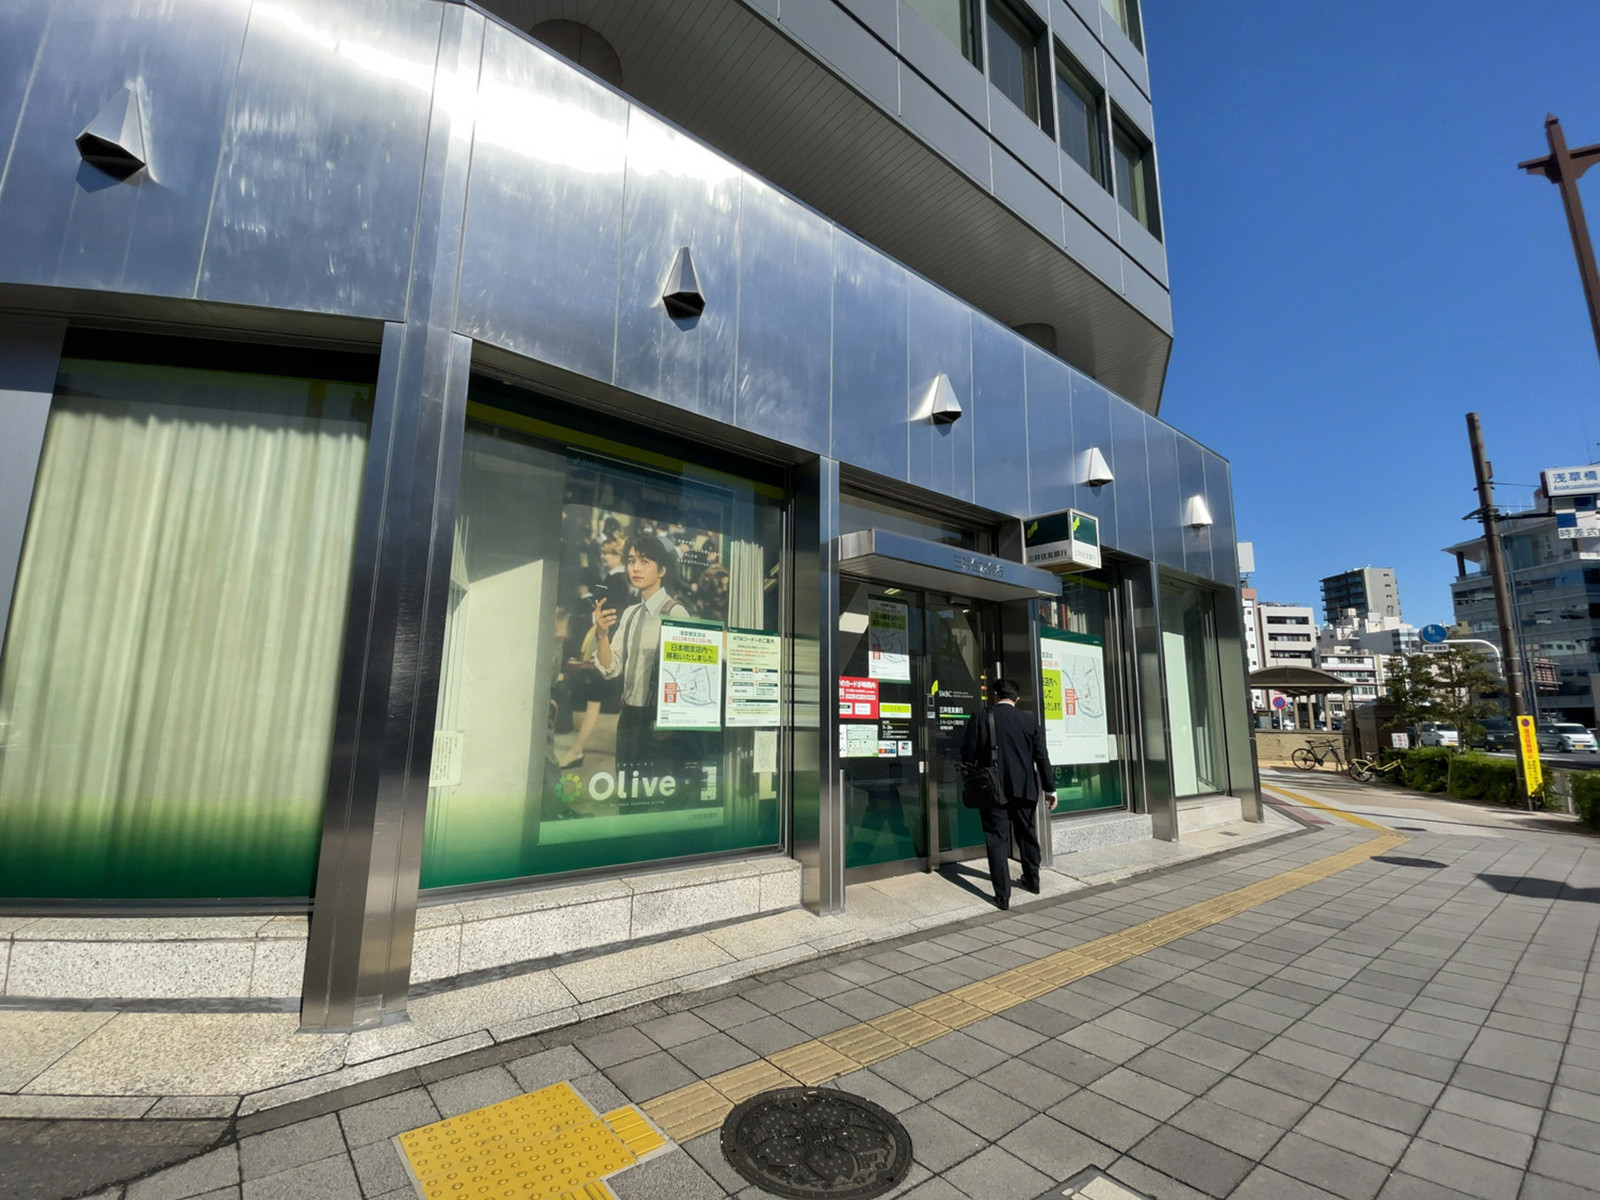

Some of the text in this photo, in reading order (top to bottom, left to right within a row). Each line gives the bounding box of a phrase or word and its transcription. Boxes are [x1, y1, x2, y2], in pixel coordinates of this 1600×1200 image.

[1553, 471, 1598, 484] 浅草橋
[1028, 549, 1068, 563] 三井住友銀行
[671, 644, 713, 654] 日本橋支店内へ
[938, 690, 952, 698] SMBC
[588, 770, 676, 800] Olive
